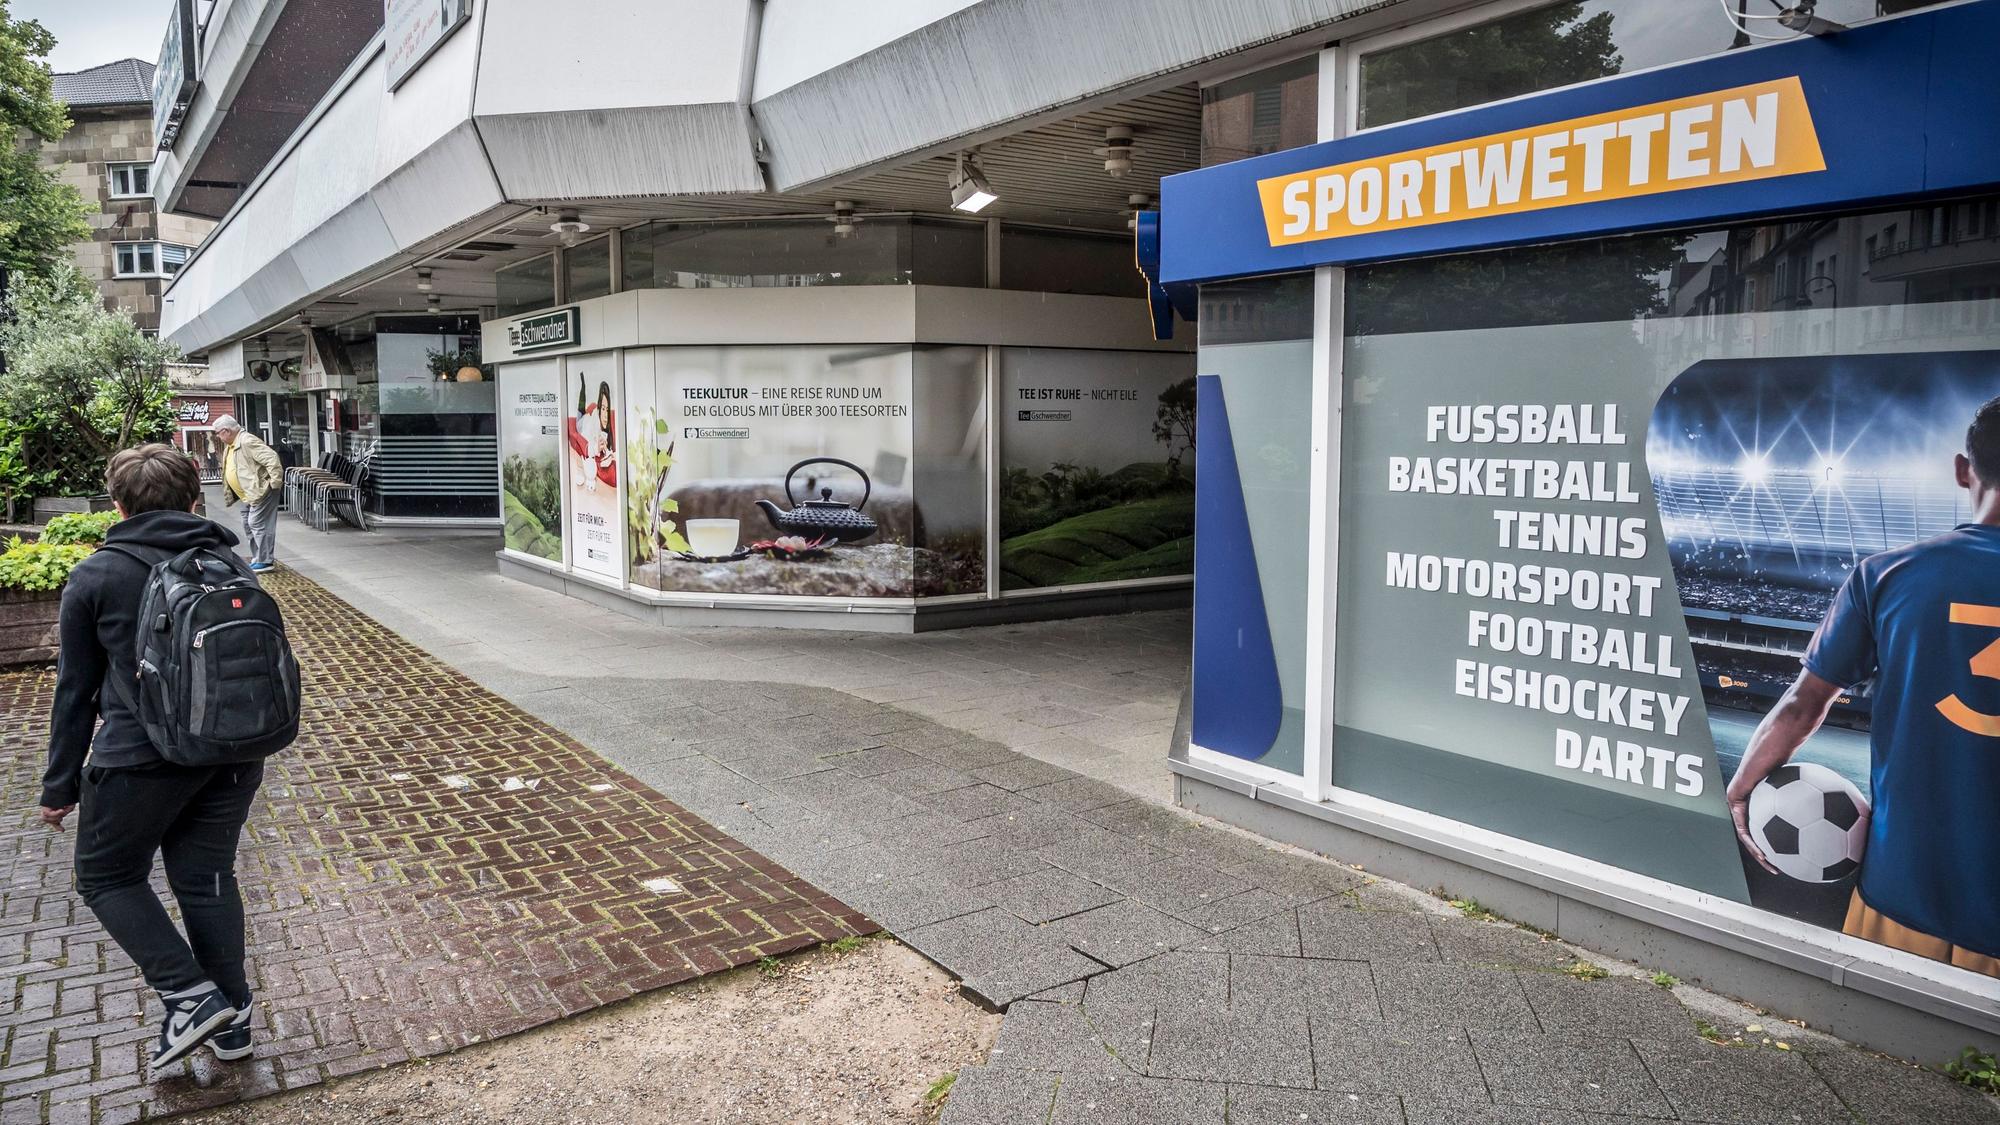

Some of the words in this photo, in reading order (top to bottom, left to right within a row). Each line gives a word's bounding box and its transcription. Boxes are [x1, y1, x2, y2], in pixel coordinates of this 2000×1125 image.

[1283, 92, 1778, 237] SPORTWETTEN
[520, 317, 566, 344] Gschwendner
[682, 387, 749, 400] TEEKULTUR
[762, 387, 788, 399] EINE
[790, 387, 823, 399] REISE
[826, 387, 859, 399] RUND
[862, 387, 882, 399] UM
[683, 405, 706, 417] DEN
[709, 405, 756, 417] GLOBUS
[759, 405, 779, 417] MIT
[782, 403, 812, 417] ÜBER
[815, 405, 838, 418] 300
[839, 405, 907, 417] TEESORTEN
[1018, 388, 1036, 400] TEE
[1038, 388, 1053, 400] IST
[1055, 388, 1081, 400] RUHE
[1091, 389, 1118, 401] NICHT
[1120, 389, 1137, 401] EILE
[1031, 411, 1070, 420] Gschwendner
[699, 429, 747, 437] Gschwendner
[1427, 404, 1626, 445] FUSSBALL
[1388, 456, 1640, 503] BASKETBALL
[1493, 509, 1647, 559] TENNIS
[1386, 551, 1661, 617] MOTORSPORT
[1468, 609, 1682, 679] FOOTBALL
[1455, 658, 1691, 736] EISHOCKEY
[1554, 727, 1704, 798] DARTS
